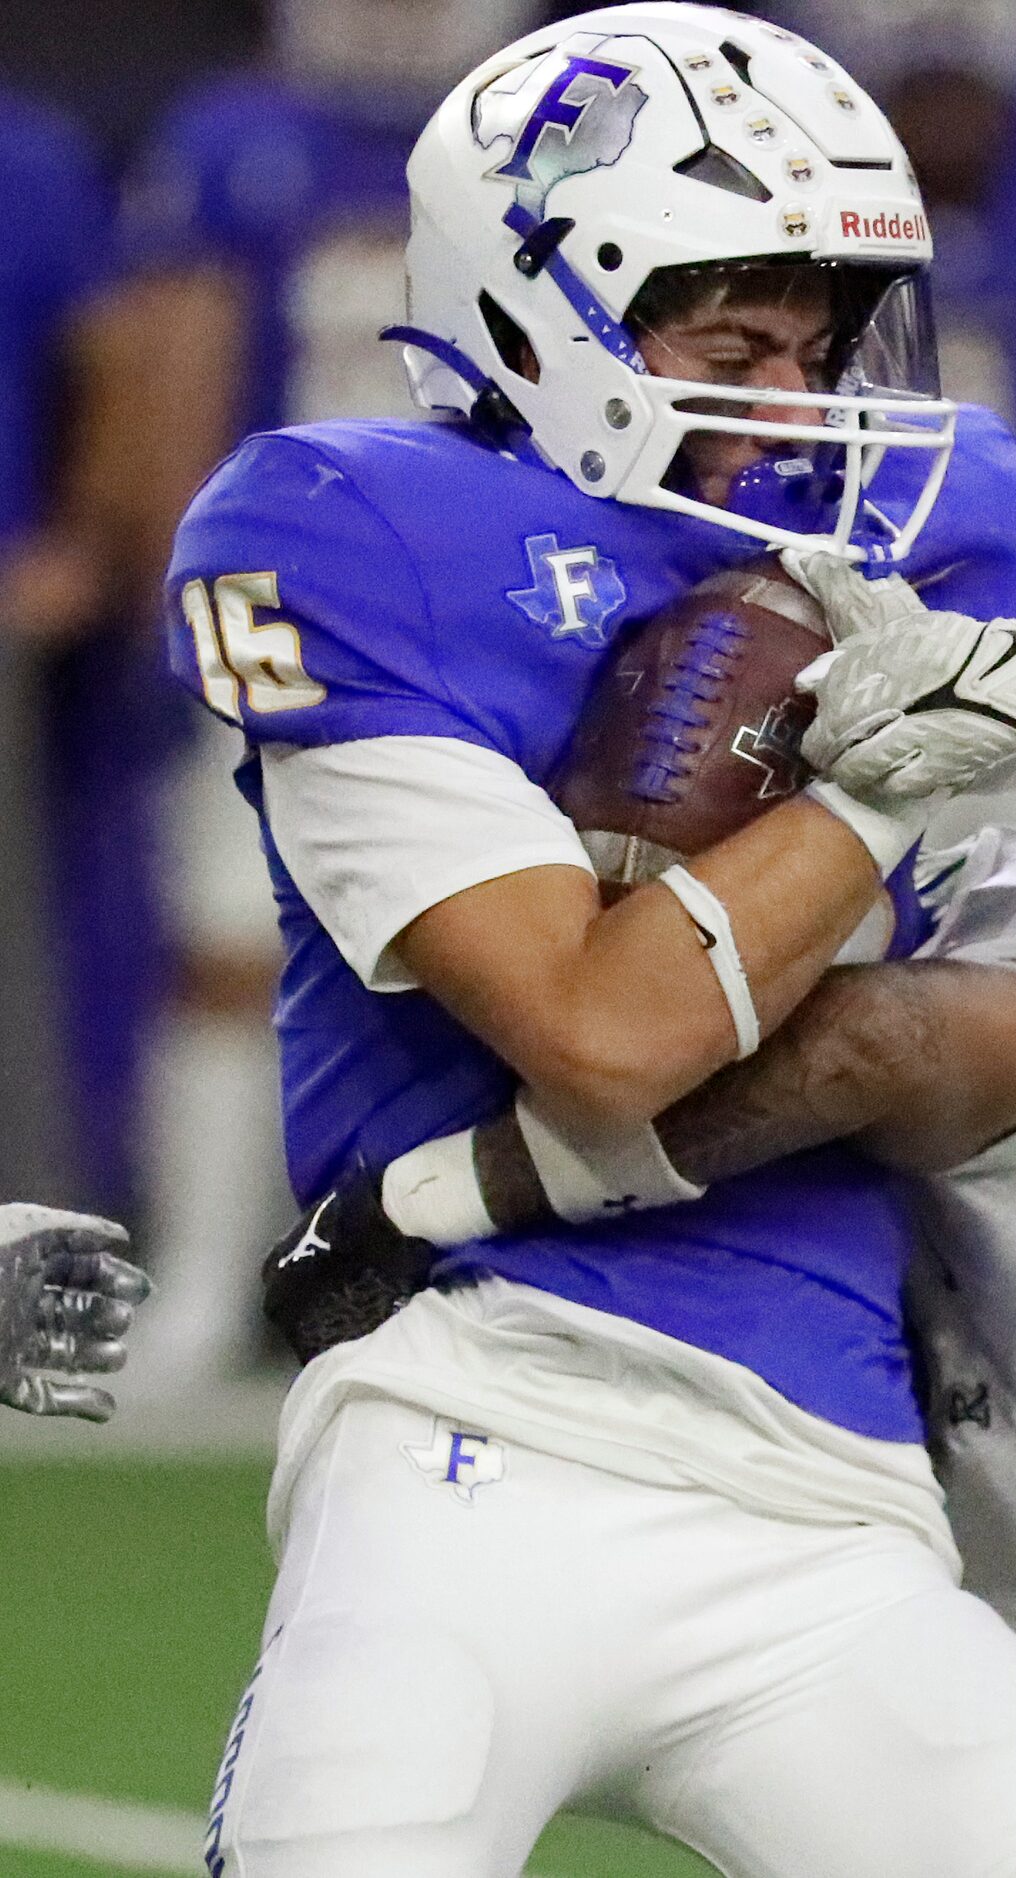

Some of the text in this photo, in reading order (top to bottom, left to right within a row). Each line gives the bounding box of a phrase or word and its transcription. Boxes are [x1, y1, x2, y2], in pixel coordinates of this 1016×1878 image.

[481, 52, 641, 187] F
[840, 210, 926, 241] Riddell
[541, 545, 599, 638] F
[181, 570, 328, 726] 16
[440, 1432, 489, 1485] F
